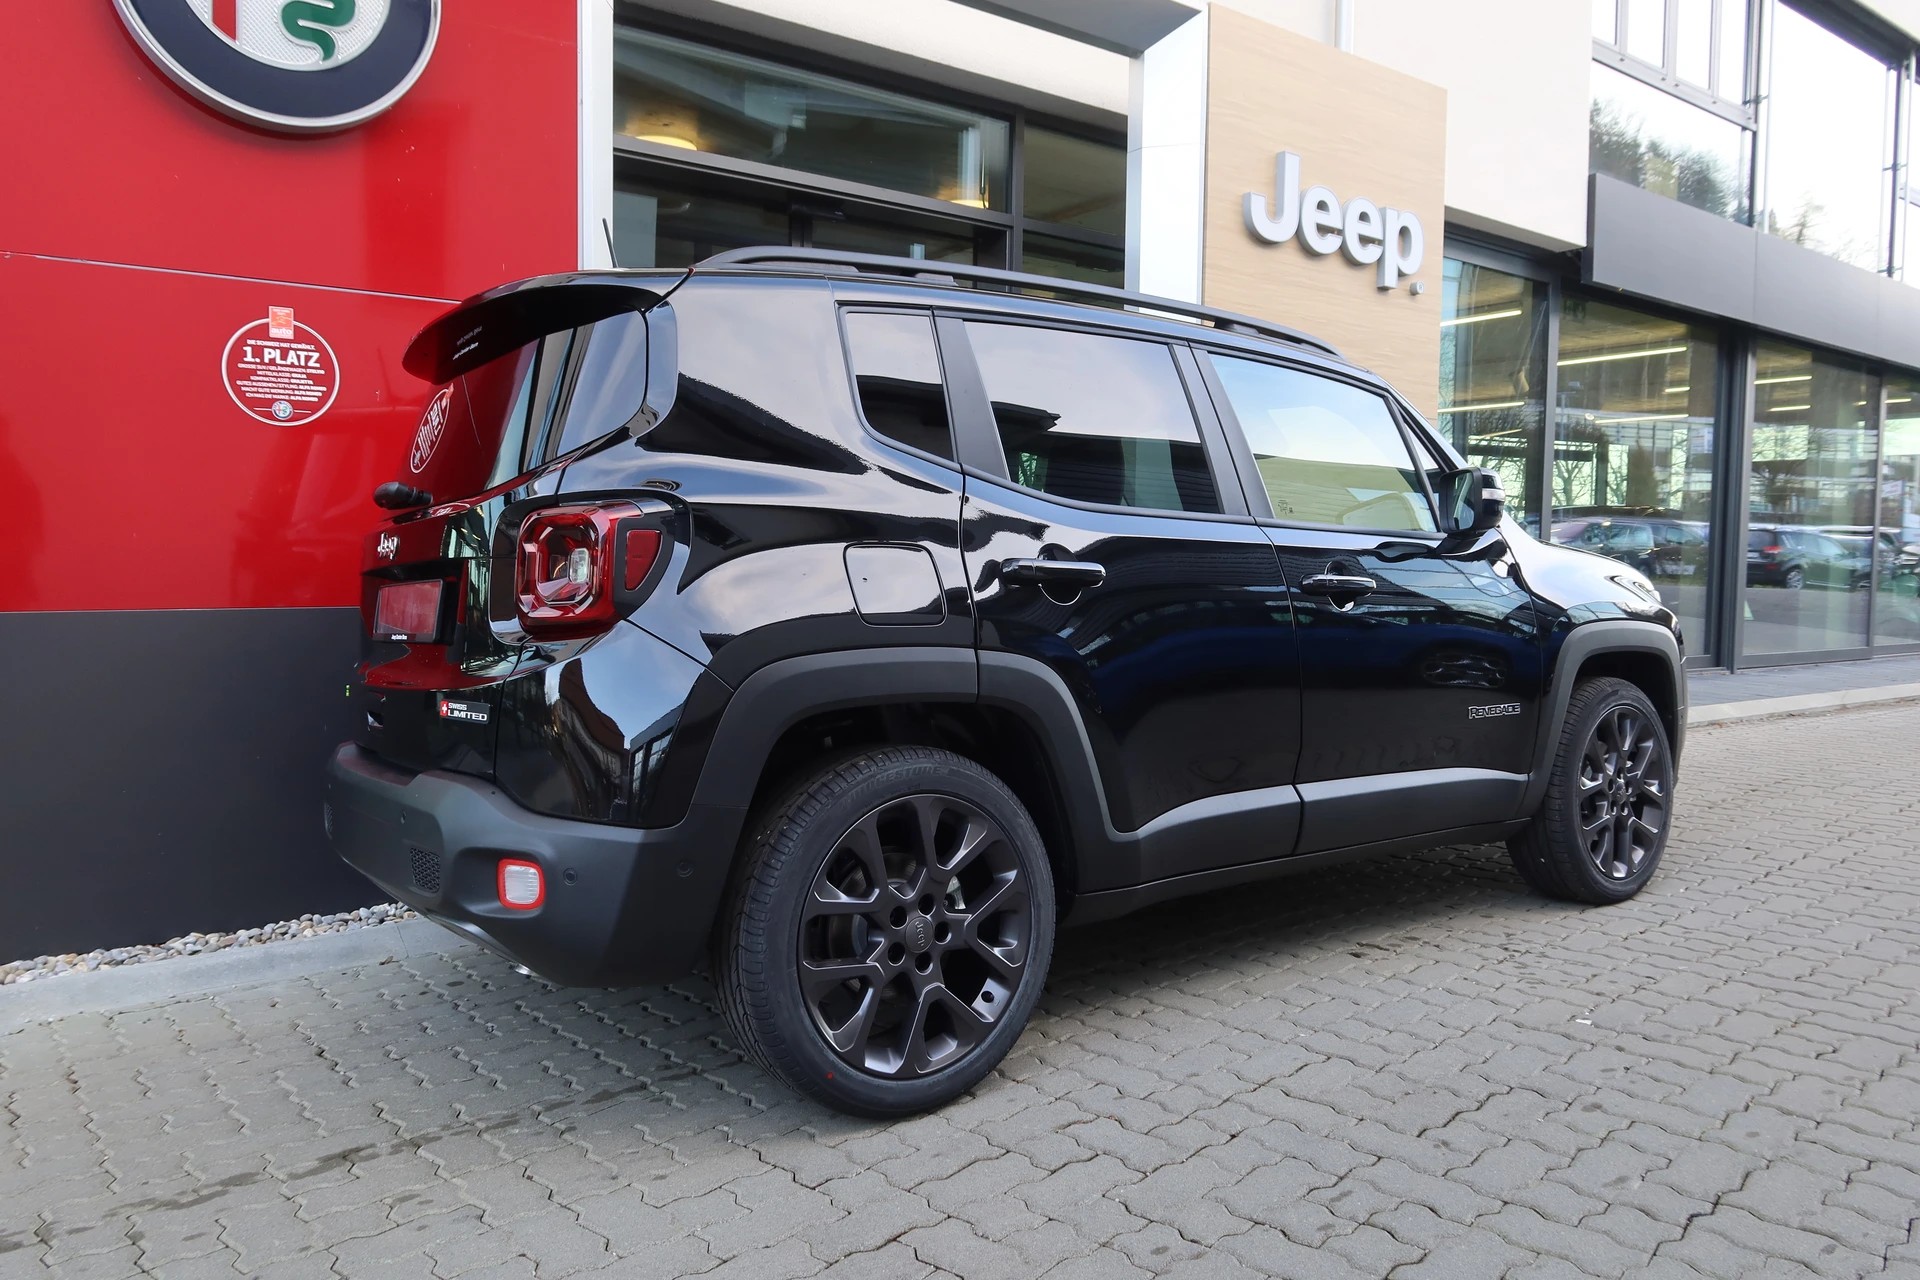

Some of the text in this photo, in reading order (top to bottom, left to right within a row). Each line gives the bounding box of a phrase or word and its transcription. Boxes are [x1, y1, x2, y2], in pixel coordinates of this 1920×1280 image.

[1242, 151, 1423, 289] Jeep
[243, 346, 321, 368] 1. PLATZ
[447, 709, 488, 721] LIMITED
[448, 702, 468, 711] SWISS
[1468, 702, 1521, 720] RENEGADE
